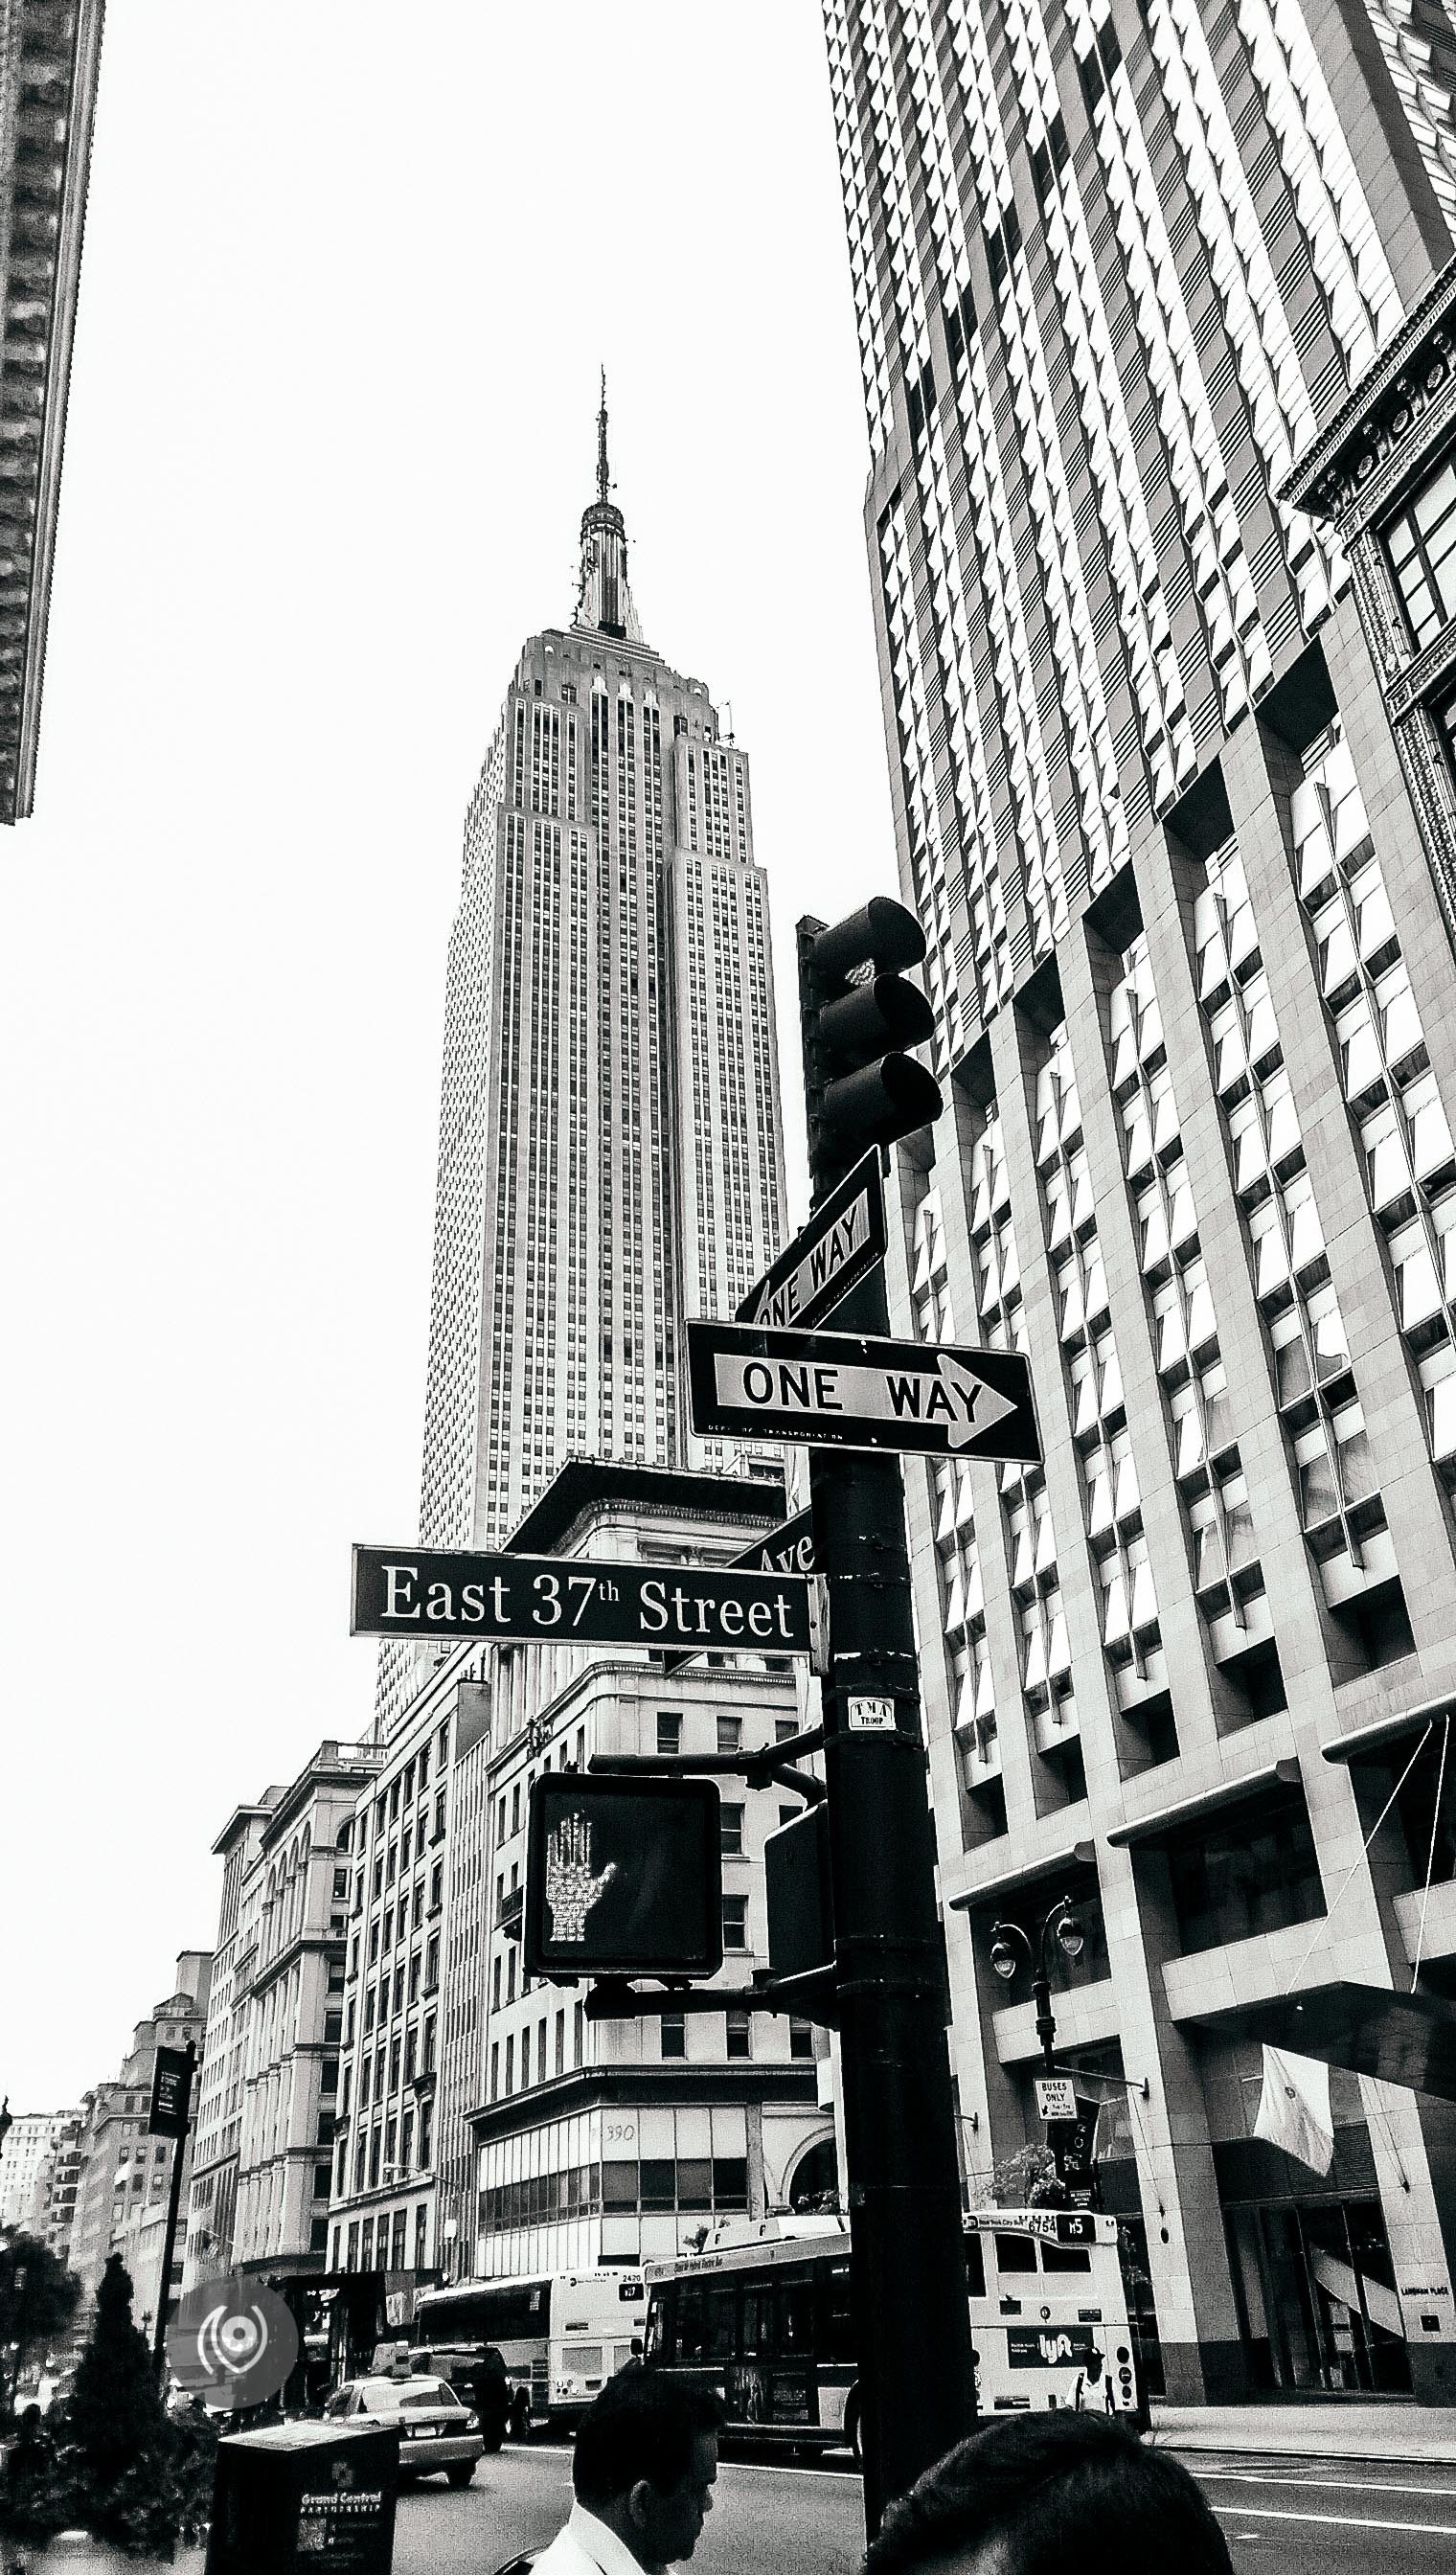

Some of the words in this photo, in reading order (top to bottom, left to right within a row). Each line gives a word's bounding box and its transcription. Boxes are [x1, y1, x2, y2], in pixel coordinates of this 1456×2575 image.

[810, 1203, 857, 1293] WAY
[742, 1361, 844, 1411] ONE
[885, 1376, 983, 1424] WAY
[763, 1428, 844, 1441] TRANSPORTATON
[761, 1536, 816, 1572] Ave
[380, 1565, 512, 1624] East
[532, 1574, 621, 1627] 37th
[639, 1581, 795, 1638] Street
[1041, 2082, 1068, 2092] BUSES
[1045, 2092, 1066, 2103] ONLY
[1028, 2221, 1057, 2233] 6754
[302, 2493, 338, 2504] Grand
[340, 2491, 382, 2504] Central
